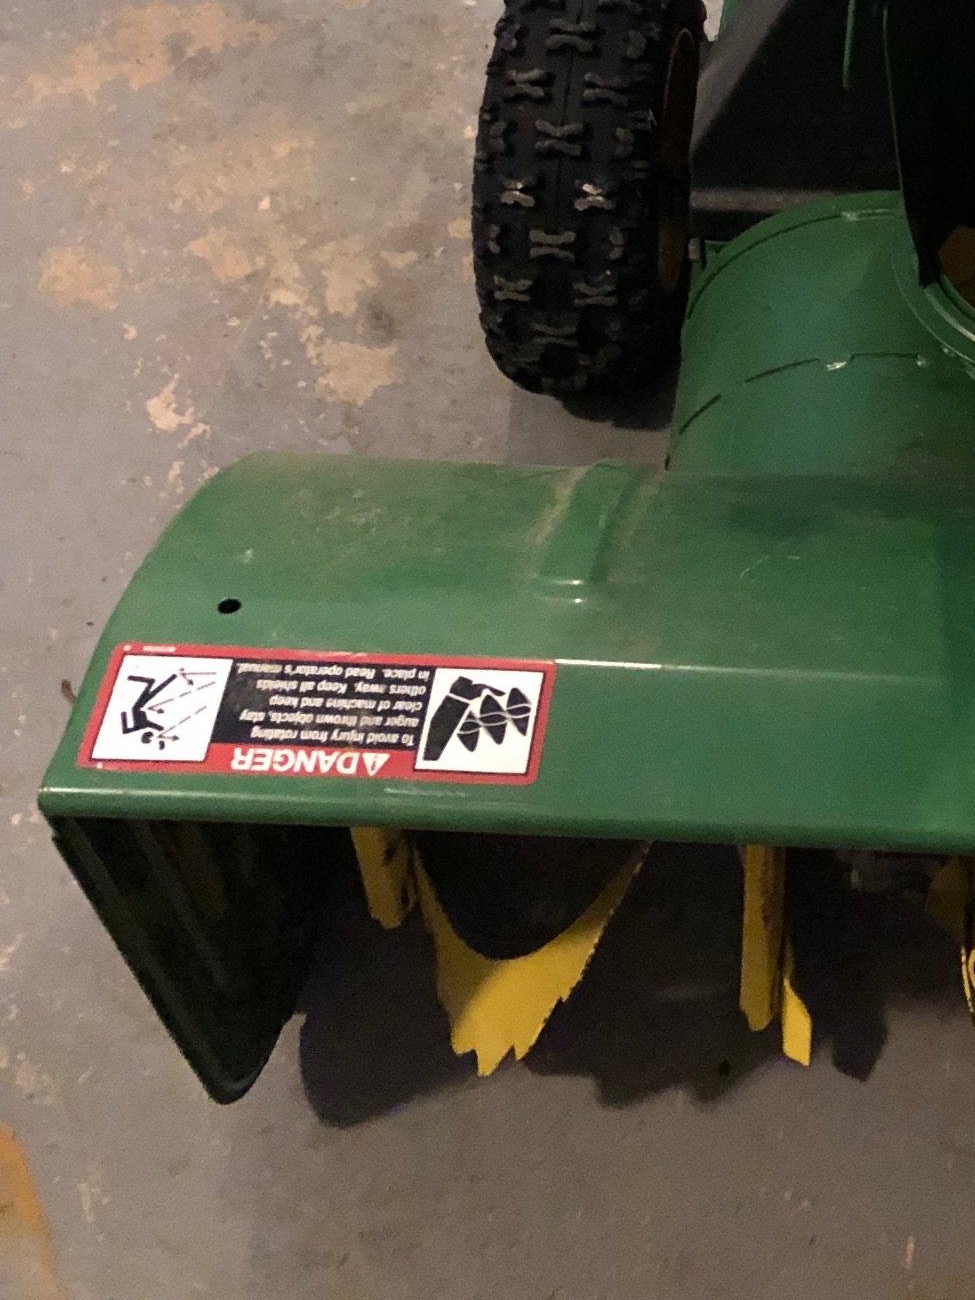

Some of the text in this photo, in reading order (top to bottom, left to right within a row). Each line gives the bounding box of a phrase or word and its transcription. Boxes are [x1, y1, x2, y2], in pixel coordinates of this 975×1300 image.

[236, 663, 430, 680] in place. Read operator's manual.
[256, 679, 426, 697] others away. Keep all shields
[269, 695, 423, 712] clear of machine and keep
[239, 708, 420, 729] auger and thrown objects, stay
[250, 726, 415, 746] To avoid injury from rotating
[231, 747, 361, 773] DANGER
